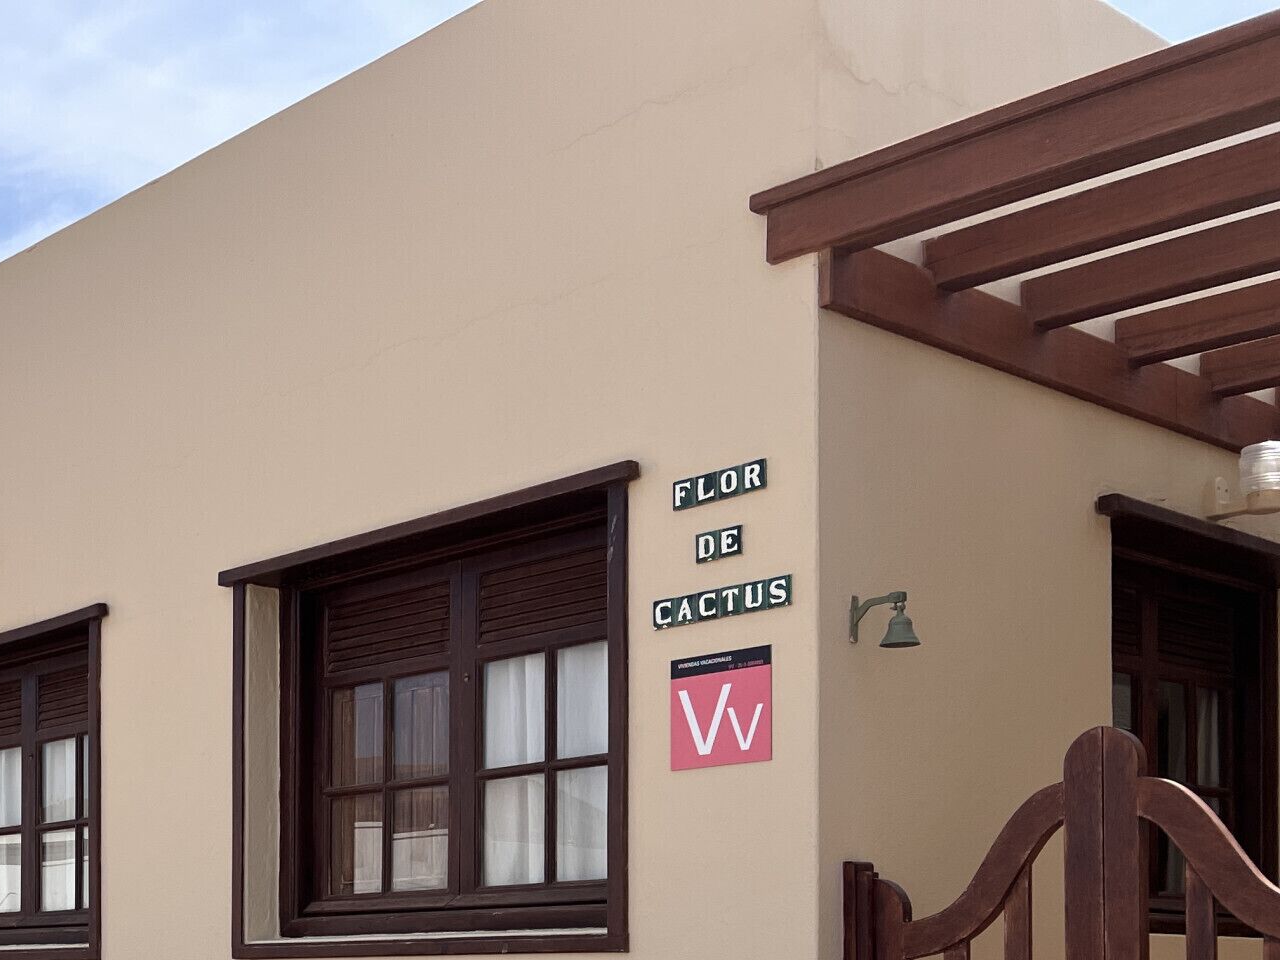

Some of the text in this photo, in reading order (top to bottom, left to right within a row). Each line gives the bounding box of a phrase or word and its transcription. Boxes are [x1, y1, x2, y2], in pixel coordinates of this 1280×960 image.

[674, 462, 762, 507] FLOR
[697, 529, 739, 559] DE
[655, 577, 788, 626] CACTUS
[677, 661, 700, 669] VIVIENDAS
[700, 655, 732, 665] VACACIONALES
